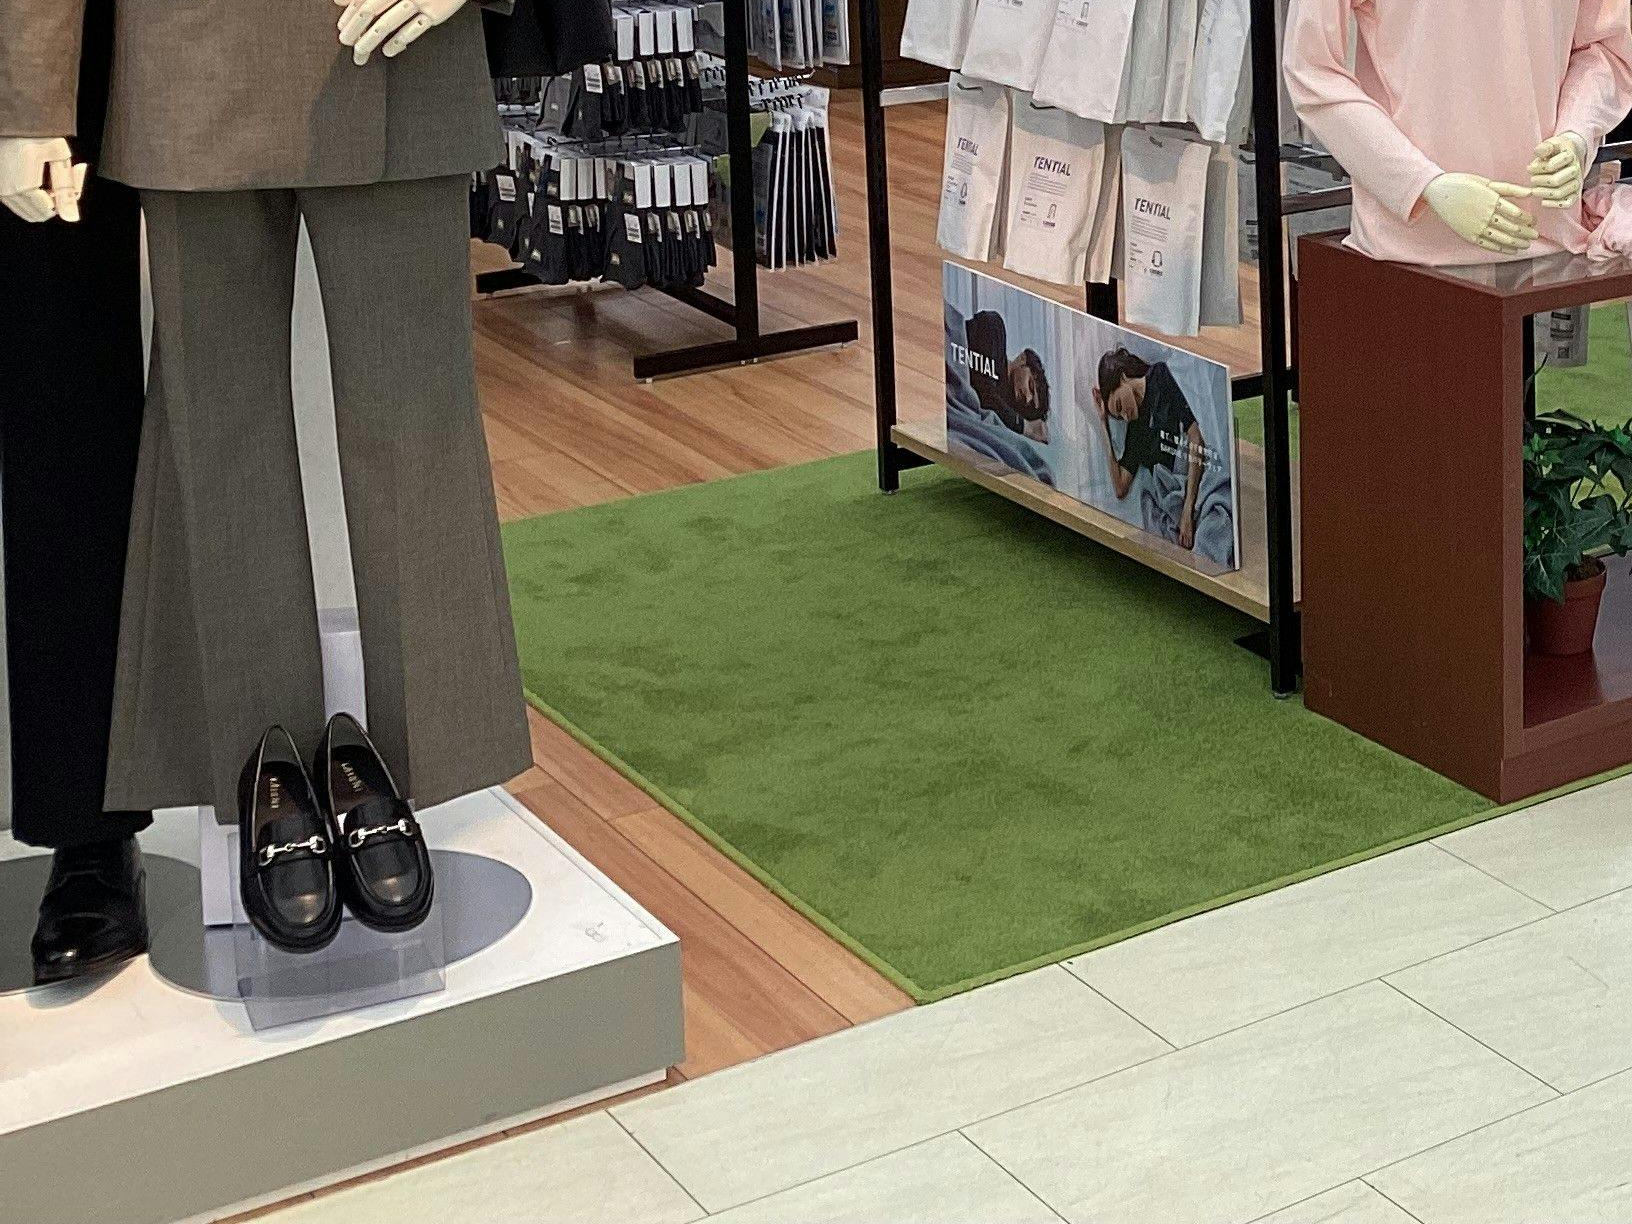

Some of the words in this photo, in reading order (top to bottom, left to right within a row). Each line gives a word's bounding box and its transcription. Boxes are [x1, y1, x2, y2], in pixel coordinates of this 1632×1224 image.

[1033, 155, 1072, 177] TENTIAL
[1133, 196, 1172, 221] TENTIAL
[951, 342, 999, 380] TENTIAL
